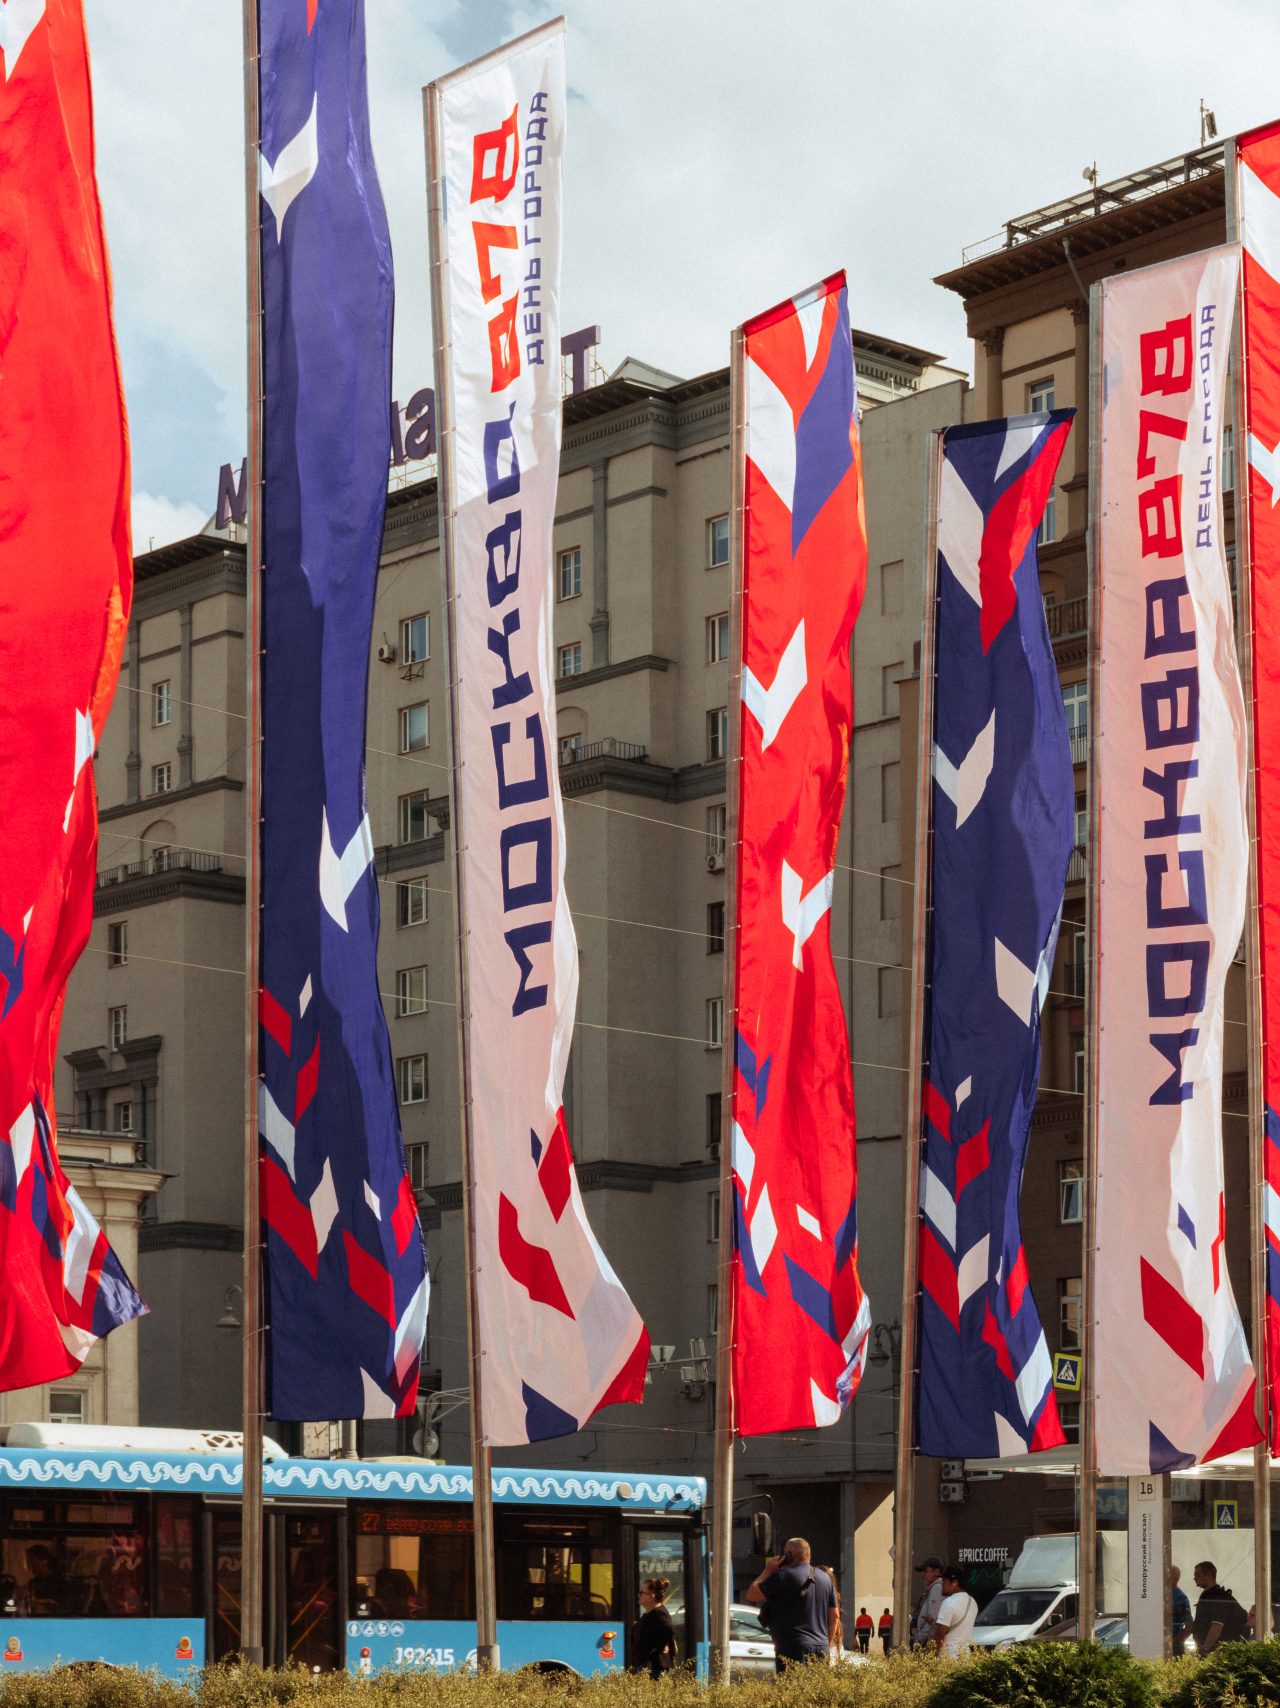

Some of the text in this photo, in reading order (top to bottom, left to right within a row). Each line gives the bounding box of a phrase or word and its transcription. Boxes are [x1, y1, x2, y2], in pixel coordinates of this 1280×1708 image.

[523, 91, 548, 366] ДЕНЬ ГОРОДА
[469, 101, 554, 1017] МОСКВА 878
[1196, 454, 1213, 548] ДЕНЬ
[1136, 312, 1211, 1106] МОСКВА 878
[963, 1548, 984, 1562] PRICE
[984, 1547, 1009, 1562] COFFEE
[1140, 1544, 1148, 1599] Белорусский
